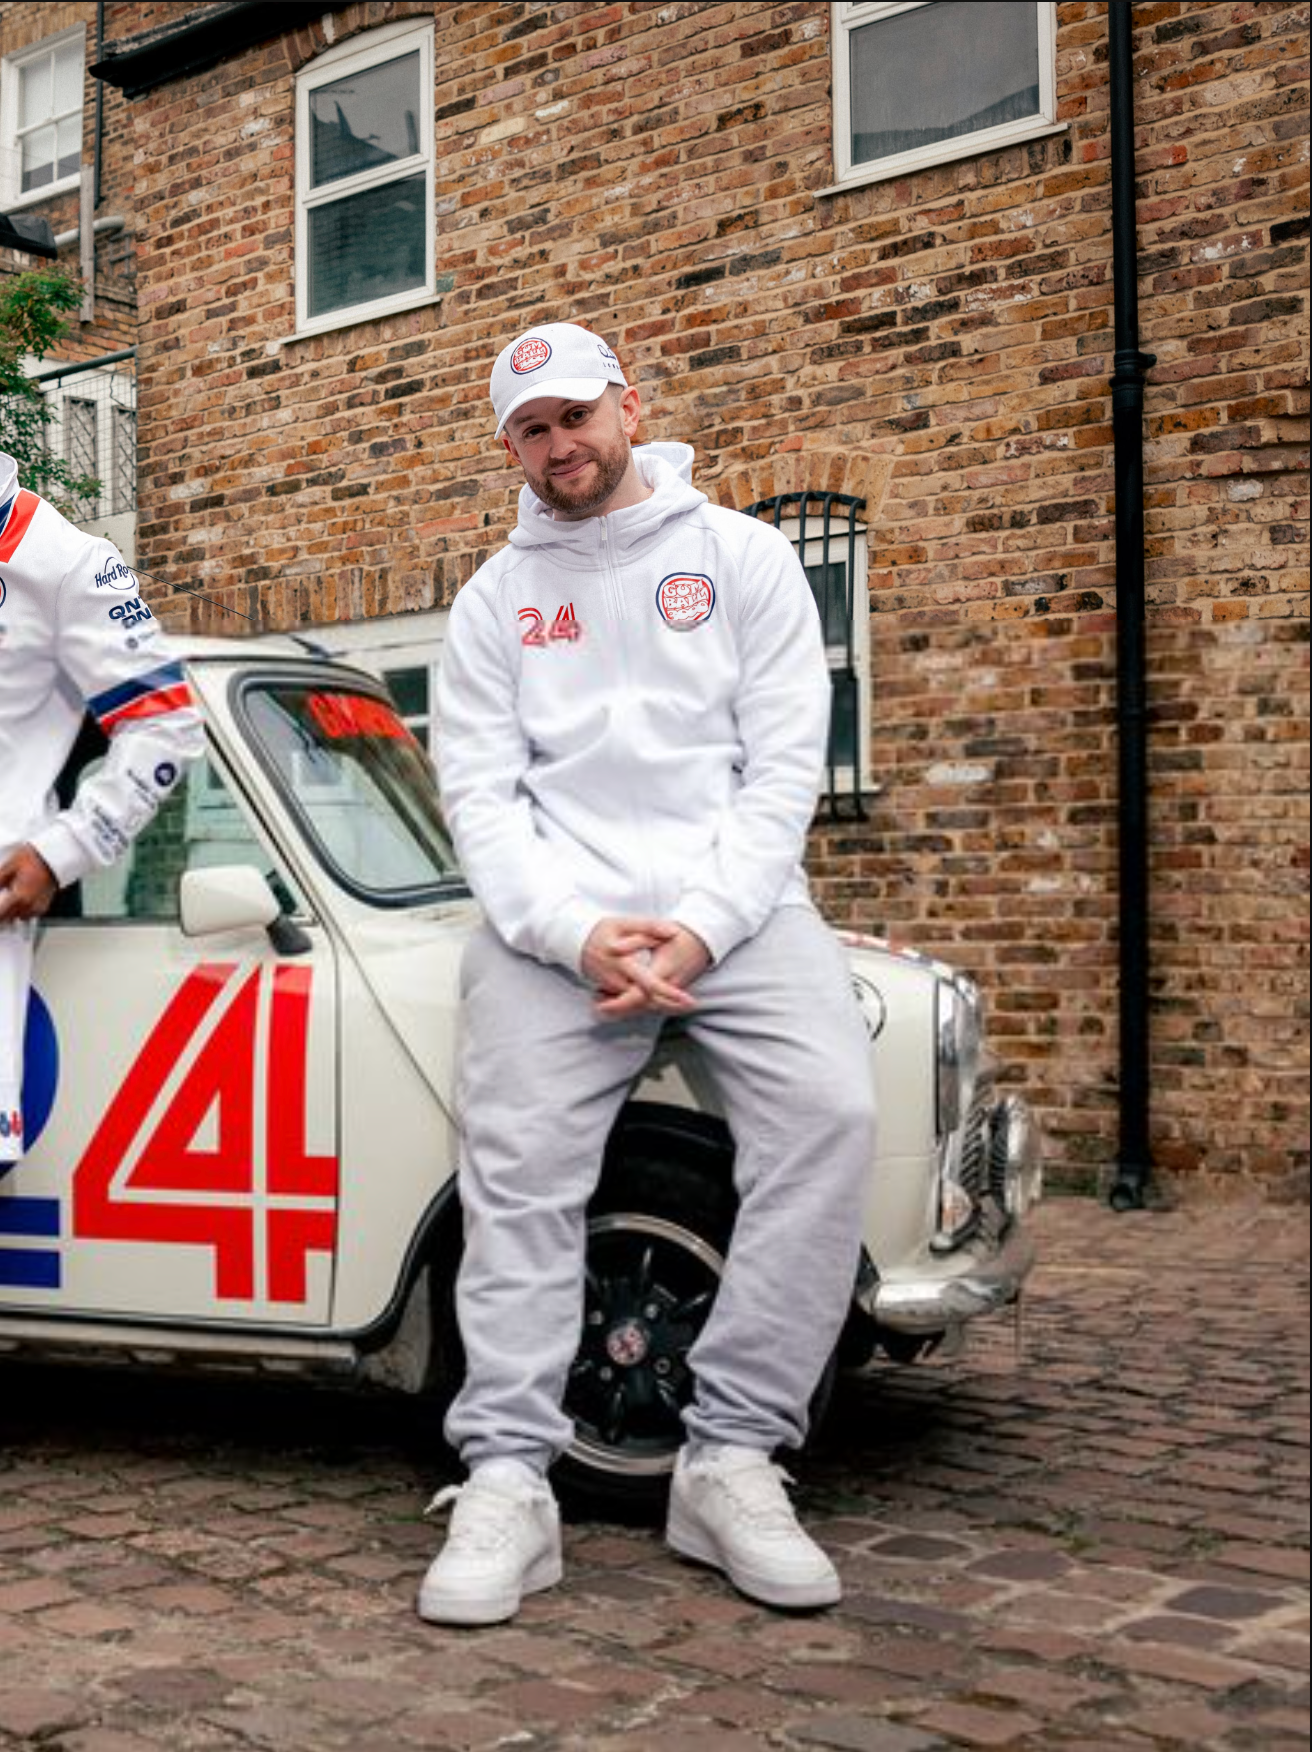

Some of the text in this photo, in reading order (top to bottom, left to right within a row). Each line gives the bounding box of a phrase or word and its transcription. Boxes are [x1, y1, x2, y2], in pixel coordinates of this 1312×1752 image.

[94, 563, 129, 588] Hard Ro
[663, 578, 704, 597] GUM
[108, 595, 141, 620] QN
[663, 587, 708, 609] BALL
[517, 602, 581, 647] 24
